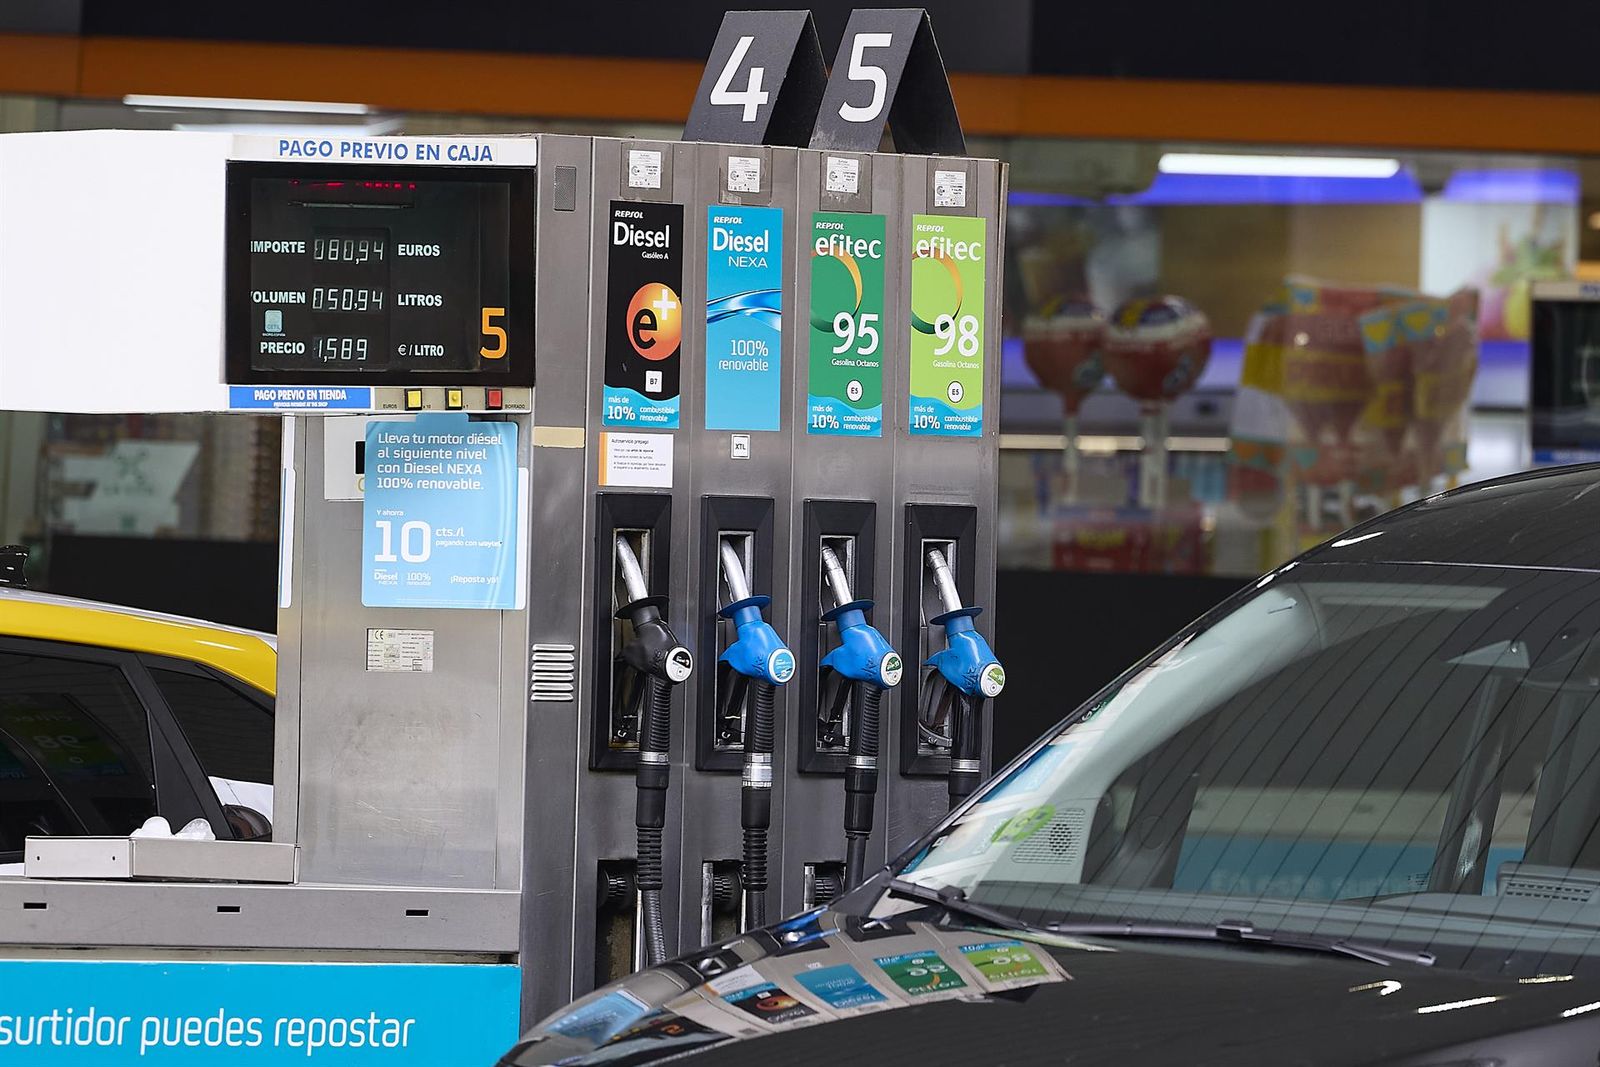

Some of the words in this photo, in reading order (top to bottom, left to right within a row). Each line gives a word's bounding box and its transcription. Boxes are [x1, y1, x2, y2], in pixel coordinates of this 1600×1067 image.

[710, 36, 769, 122] 4
[838, 33, 893, 123] 5
[279, 139, 332, 157] PAGO
[340, 141, 408, 160] PREVIO
[416, 144, 440, 161] EN
[447, 144, 493, 162] CAJA
[614, 210, 644, 219] REPSOL
[713, 216, 743, 224] REPSOL
[815, 222, 844, 230] REPSOL
[916, 224, 944, 232] REPSOL
[613, 221, 670, 249] Diesel
[712, 227, 768, 253] Diesel
[251, 241, 305, 253] IMPORTE
[314, 239, 383, 265] 080,94
[398, 244, 440, 258] EUROS
[815, 233, 882, 259] efitec
[916, 236, 982, 261] efitec
[663, 252, 669, 260] A
[728, 256, 768, 268] NEXA
[312, 288, 383, 310] 050,94
[397, 294, 442, 307] LITROS
[479, 307, 507, 359] 5
[832, 311, 879, 356] 95
[934, 314, 979, 357] 98
[260, 342, 305, 354] PRECIO
[318, 338, 367, 362] 1,589
[731, 339, 768, 357] 100%
[718, 358, 769, 372] renovable
[831, 358, 855, 367] Gasolina
[856, 359, 879, 368] Octanos
[932, 359, 956, 368] Gasolina
[957, 360, 979, 369] Octanos
[254, 389, 276, 400] PAGO
[277, 390, 305, 401] PREVIO
[306, 390, 317, 401] EN
[318, 390, 347, 402] TIENDA
[850, 387, 858, 395] E5
[951, 388, 960, 396] E5
[608, 396, 620, 404] más
[607, 405, 636, 421] 10%
[639, 406, 675, 415] combustible
[812, 404, 824, 412] más
[913, 405, 926, 413] más
[639, 414, 668, 423] renovable
[811, 414, 840, 430] 10%
[843, 415, 878, 424] combustible
[913, 414, 940, 430] 10%
[944, 415, 978, 423] combustible
[843, 423, 871, 431] renovable
[944, 423, 971, 431] renovable
[378, 433, 409, 444] Lleva
[413, 434, 425, 444] tu
[428, 434, 464, 445] motor
[467, 433, 503, 445] diésel
[735, 443, 746, 451] XTL
[377, 447, 389, 458] al
[393, 448, 452, 461] siguiente
[456, 448, 487, 460] nivel
[377, 465, 400, 474] con
[404, 463, 444, 474] Diesel
[447, 464, 482, 475] NEXA
[376, 477, 413, 489] 100%
[417, 478, 484, 490] renovable.
[382, 509, 404, 517] ahorra
[374, 520, 432, 563] 10
[435, 540, 464, 548] pagando
[374, 572, 398, 581] Diesel
[407, 572, 432, 581] 100%
[0, 1006, 130, 1047] surtidor
[140, 1008, 263, 1056] puedes
[274, 1011, 416, 1057] repostar
